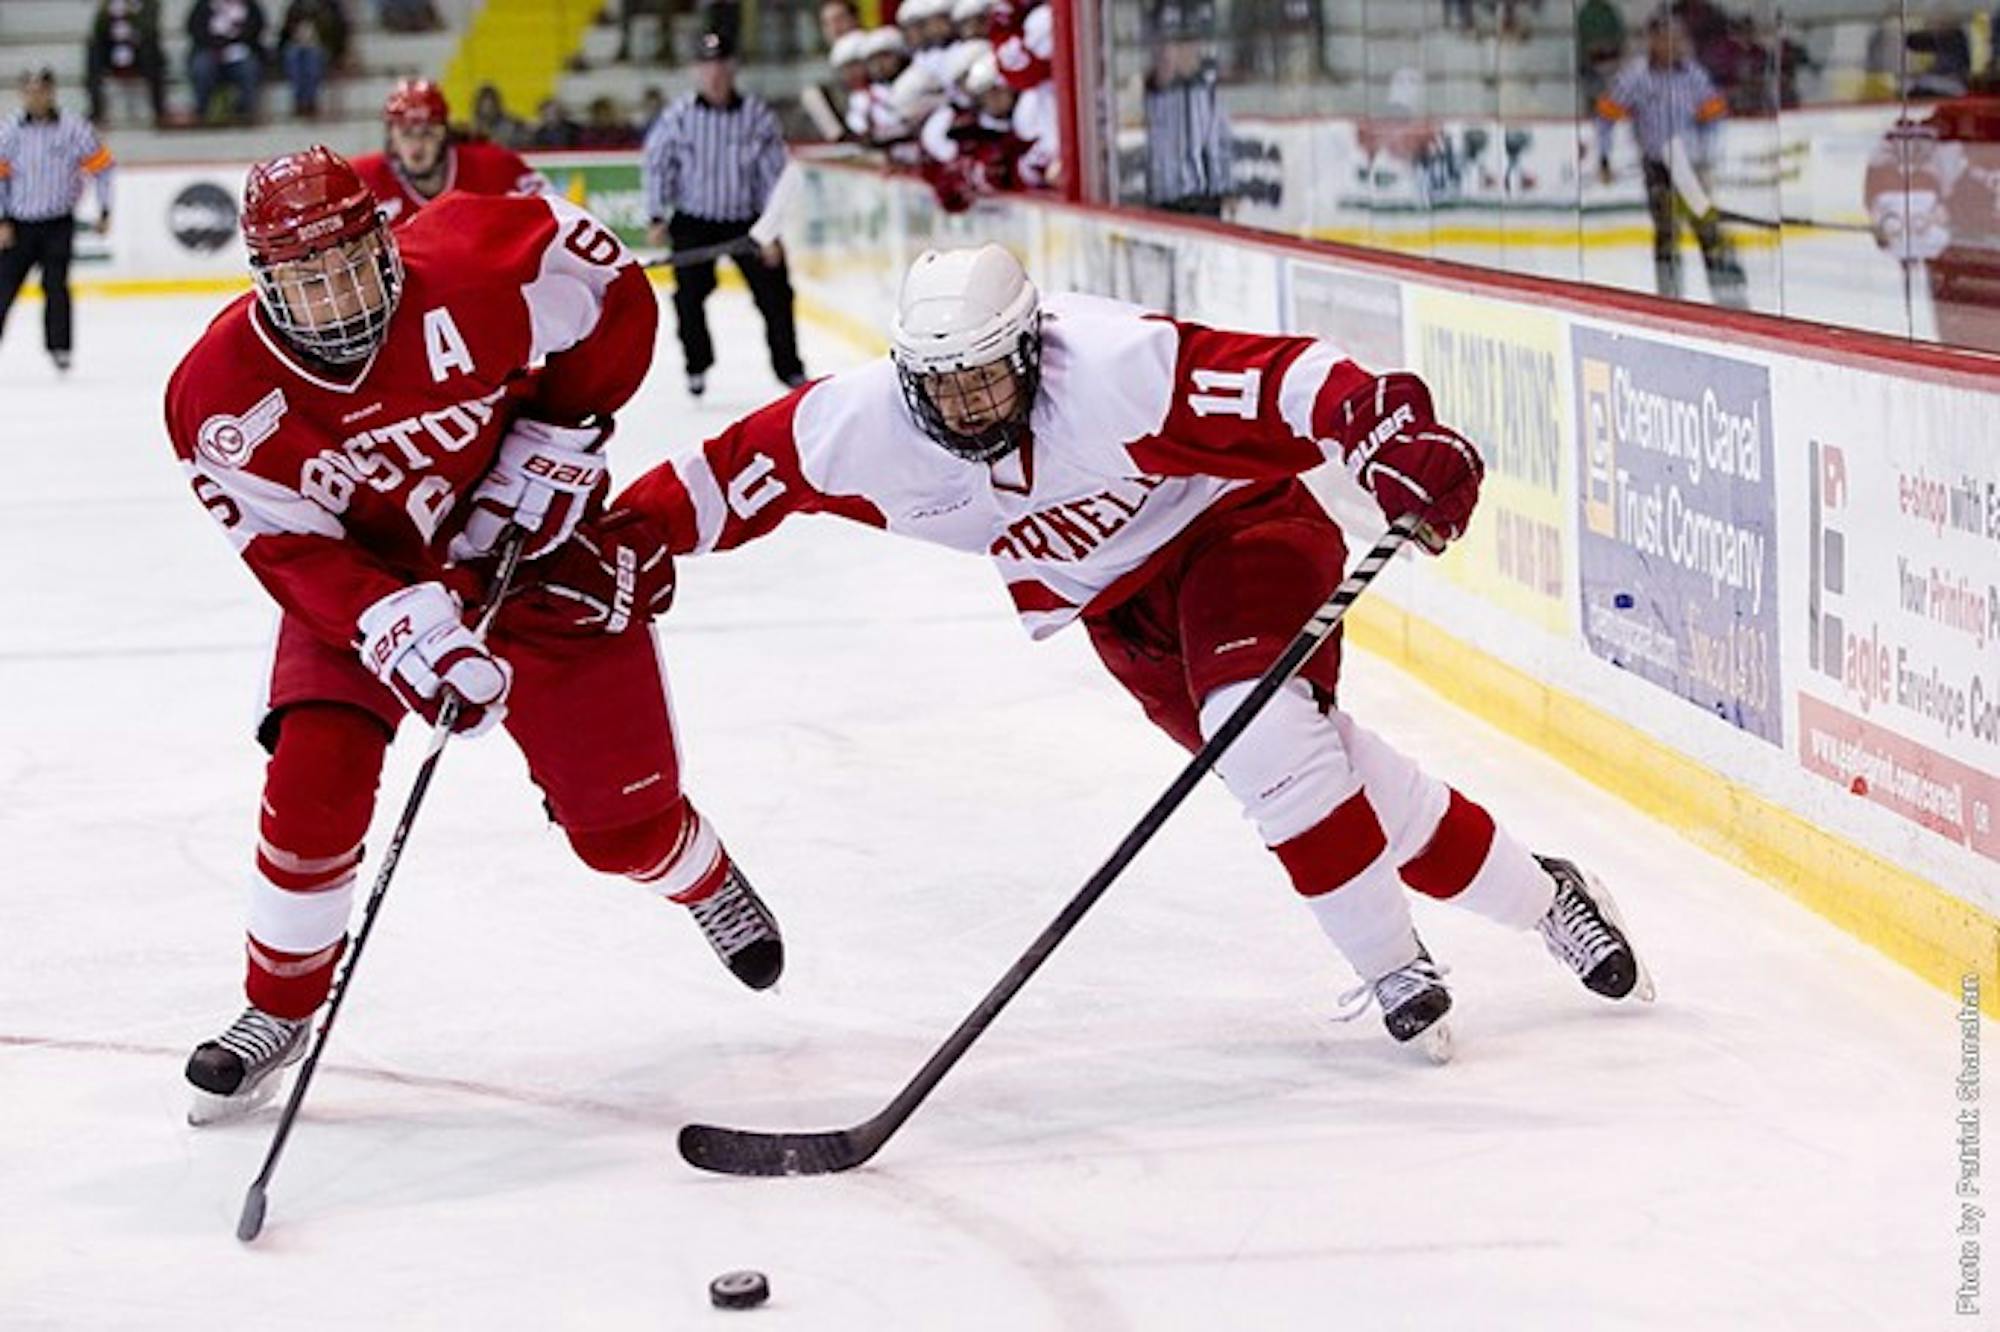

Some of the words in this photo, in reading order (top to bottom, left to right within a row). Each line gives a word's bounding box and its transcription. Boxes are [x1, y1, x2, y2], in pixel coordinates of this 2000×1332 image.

[565, 219, 622, 266] 6
[423, 306, 474, 382] A
[1188, 367, 1262, 420] 11
[1613, 365, 1702, 485] Chemung
[1702, 386, 1762, 483] Canal
[1346, 402, 1416, 474] AUER
[1897, 464, 1948, 540] e-shop
[1615, 467, 1666, 558] Trust
[1667, 484, 1766, 617] Company
[1897, 553, 1928, 616] Your
[1929, 566, 1985, 649] Printing
[1897, 647, 1965, 740] Envelope
